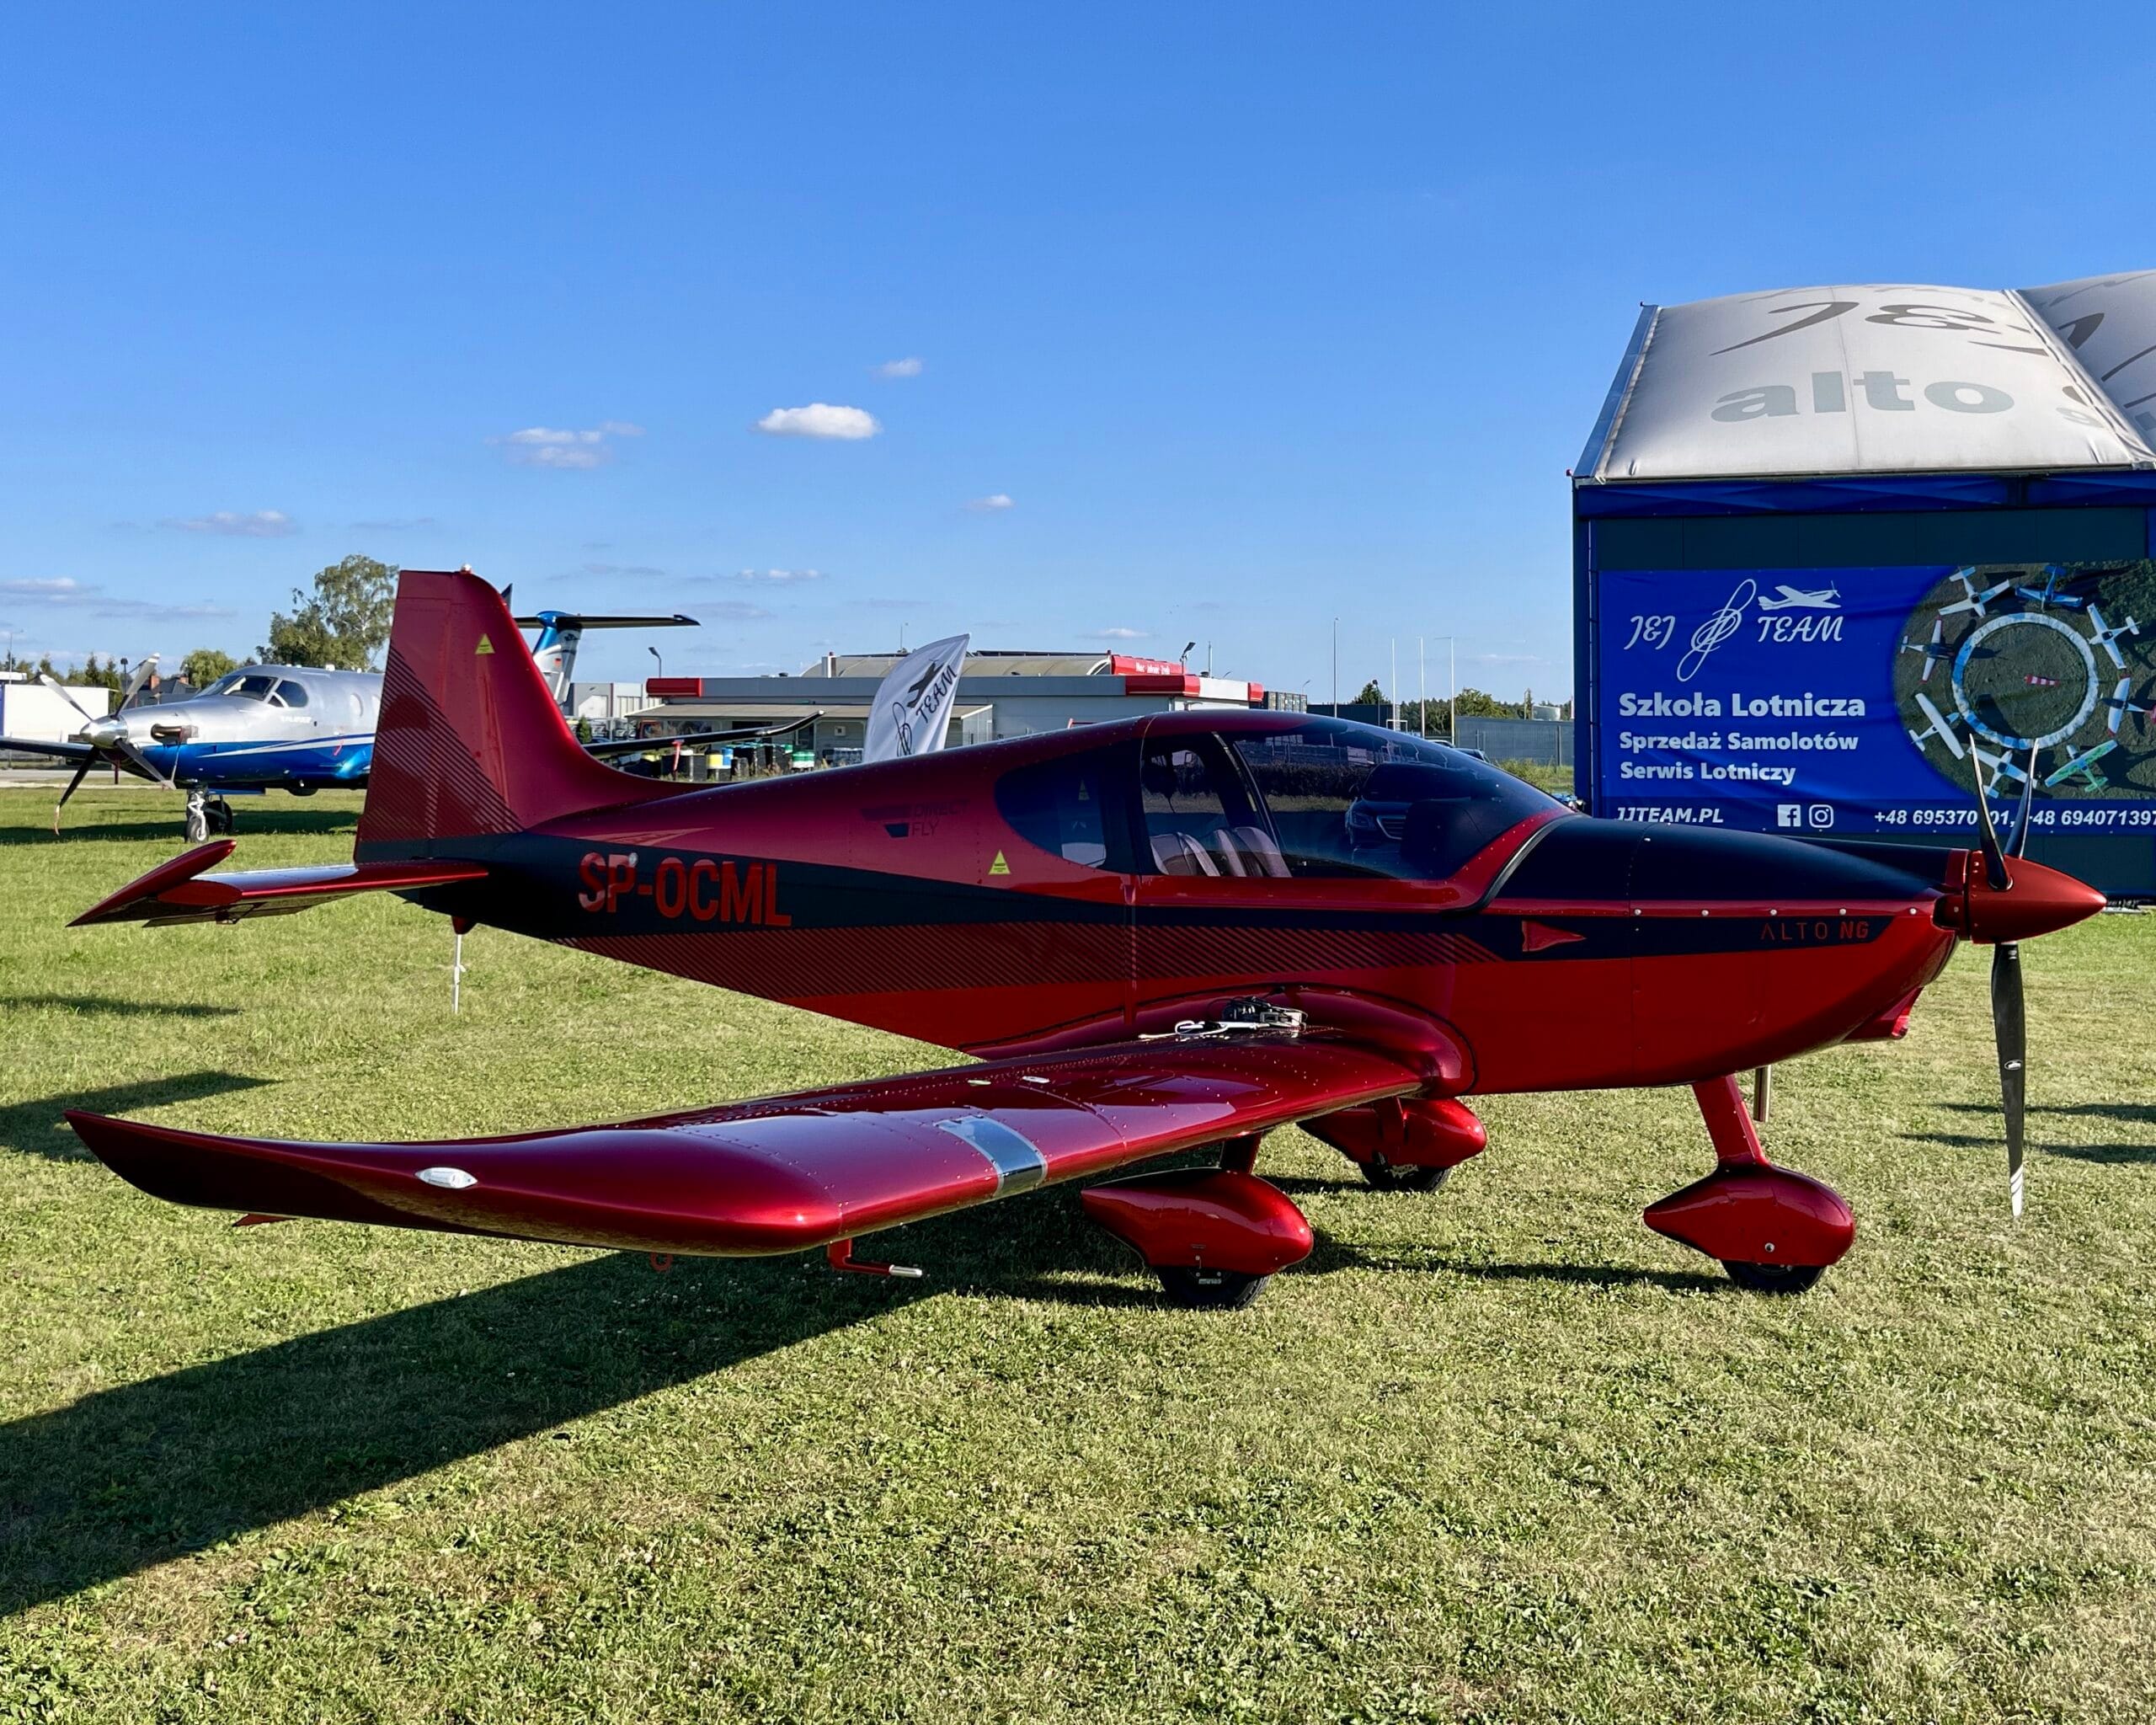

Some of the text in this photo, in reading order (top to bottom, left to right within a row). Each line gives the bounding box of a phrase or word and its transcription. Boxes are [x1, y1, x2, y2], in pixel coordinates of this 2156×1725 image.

[1710, 371, 2015, 422] alto
[1624, 616, 1844, 650] J&J TEAM
[915, 665, 958, 724] TEAM
[1619, 692, 1865, 717] Szkoła Lotnicza
[1620, 731, 1859, 753] Sprzedaż Samolotów
[1620, 761, 1796, 785] Serwis Lotniczy
[1617, 807, 1724, 824] JJTEAM.PL
[1874, 809, 1908, 825] +48
[1912, 809, 2015, 828] 69537001,
[2029, 809, 2056, 825] 48
[912, 820, 940, 836] FLY
[579, 852, 792, 927] SP-OCML
[1760, 920, 1869, 941] ALTO NG
